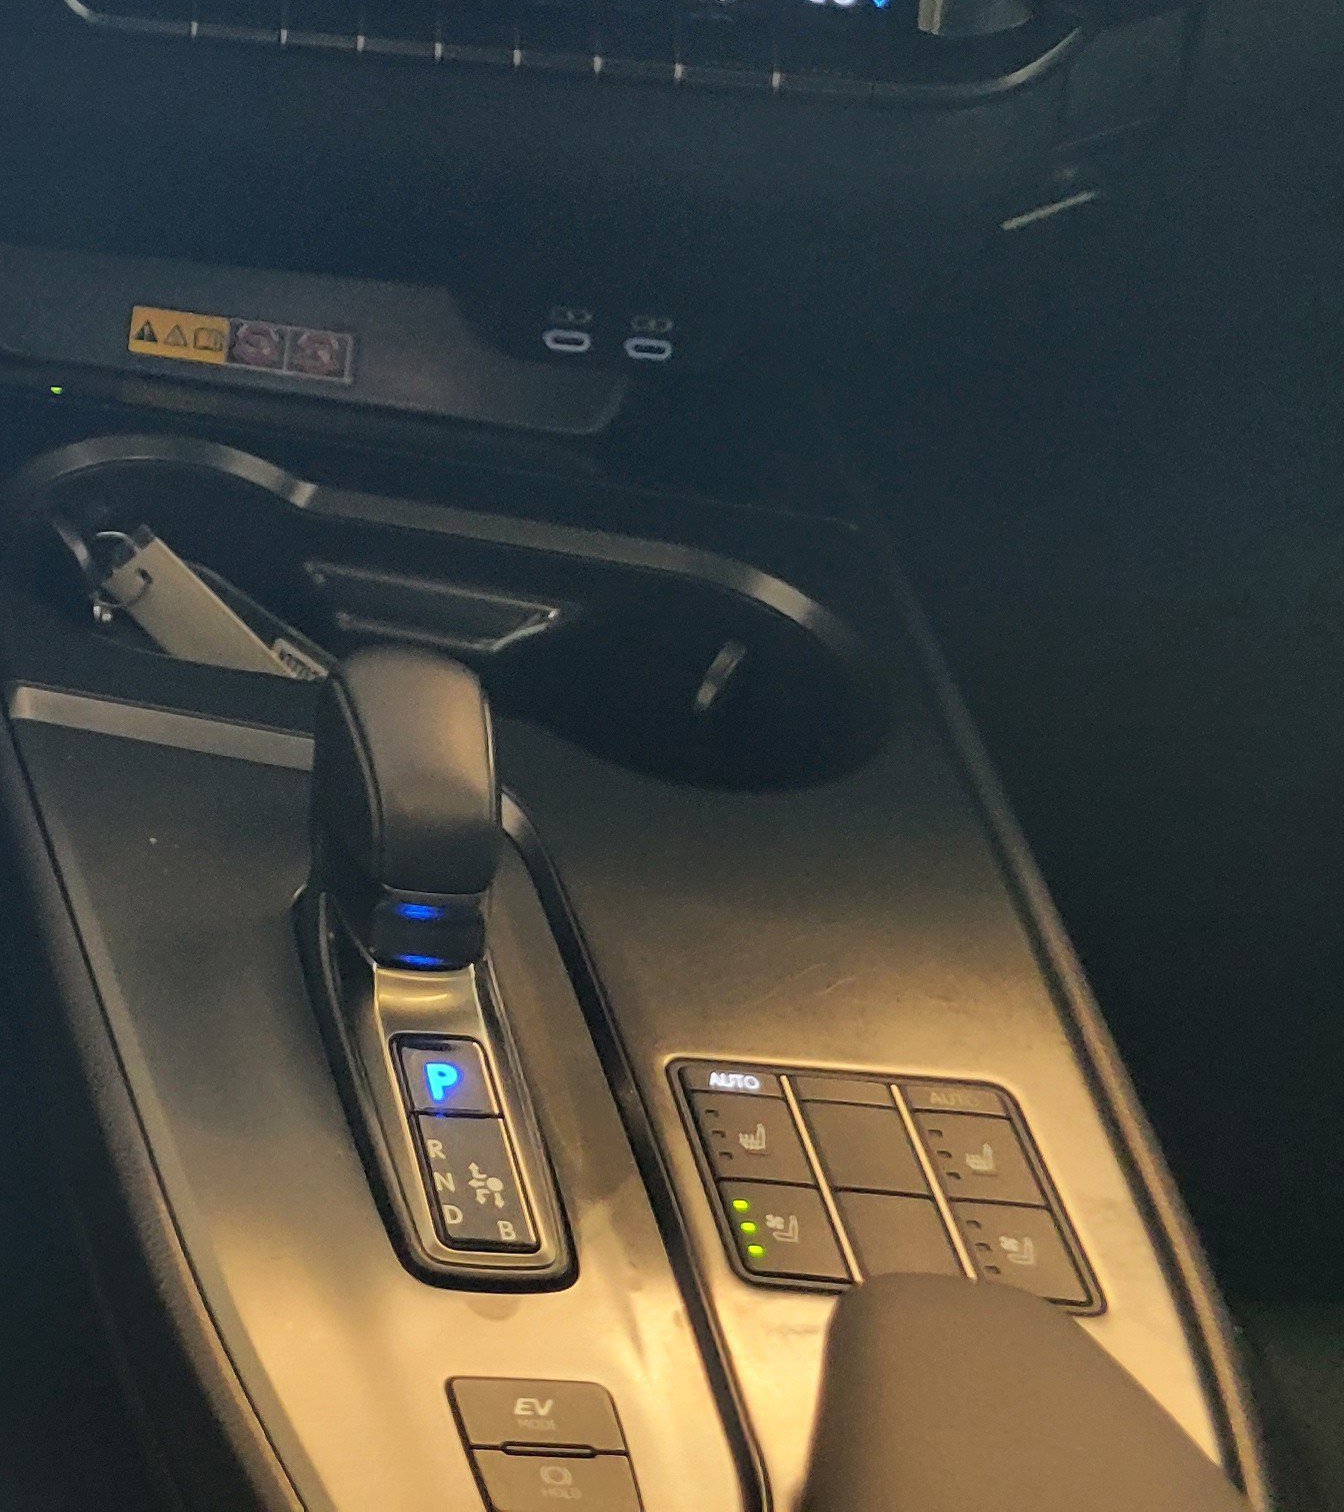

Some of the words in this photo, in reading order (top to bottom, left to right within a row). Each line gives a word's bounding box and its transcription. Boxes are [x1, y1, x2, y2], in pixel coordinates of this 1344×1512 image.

[425, 1062, 460, 1101] P
[709, 1071, 761, 1090] AUTO
[426, 1138, 446, 1160] R
[433, 1171, 456, 1193] N
[442, 1204, 463, 1225] D
[497, 1220, 516, 1240] B
[513, 1397, 554, 1416] EV
